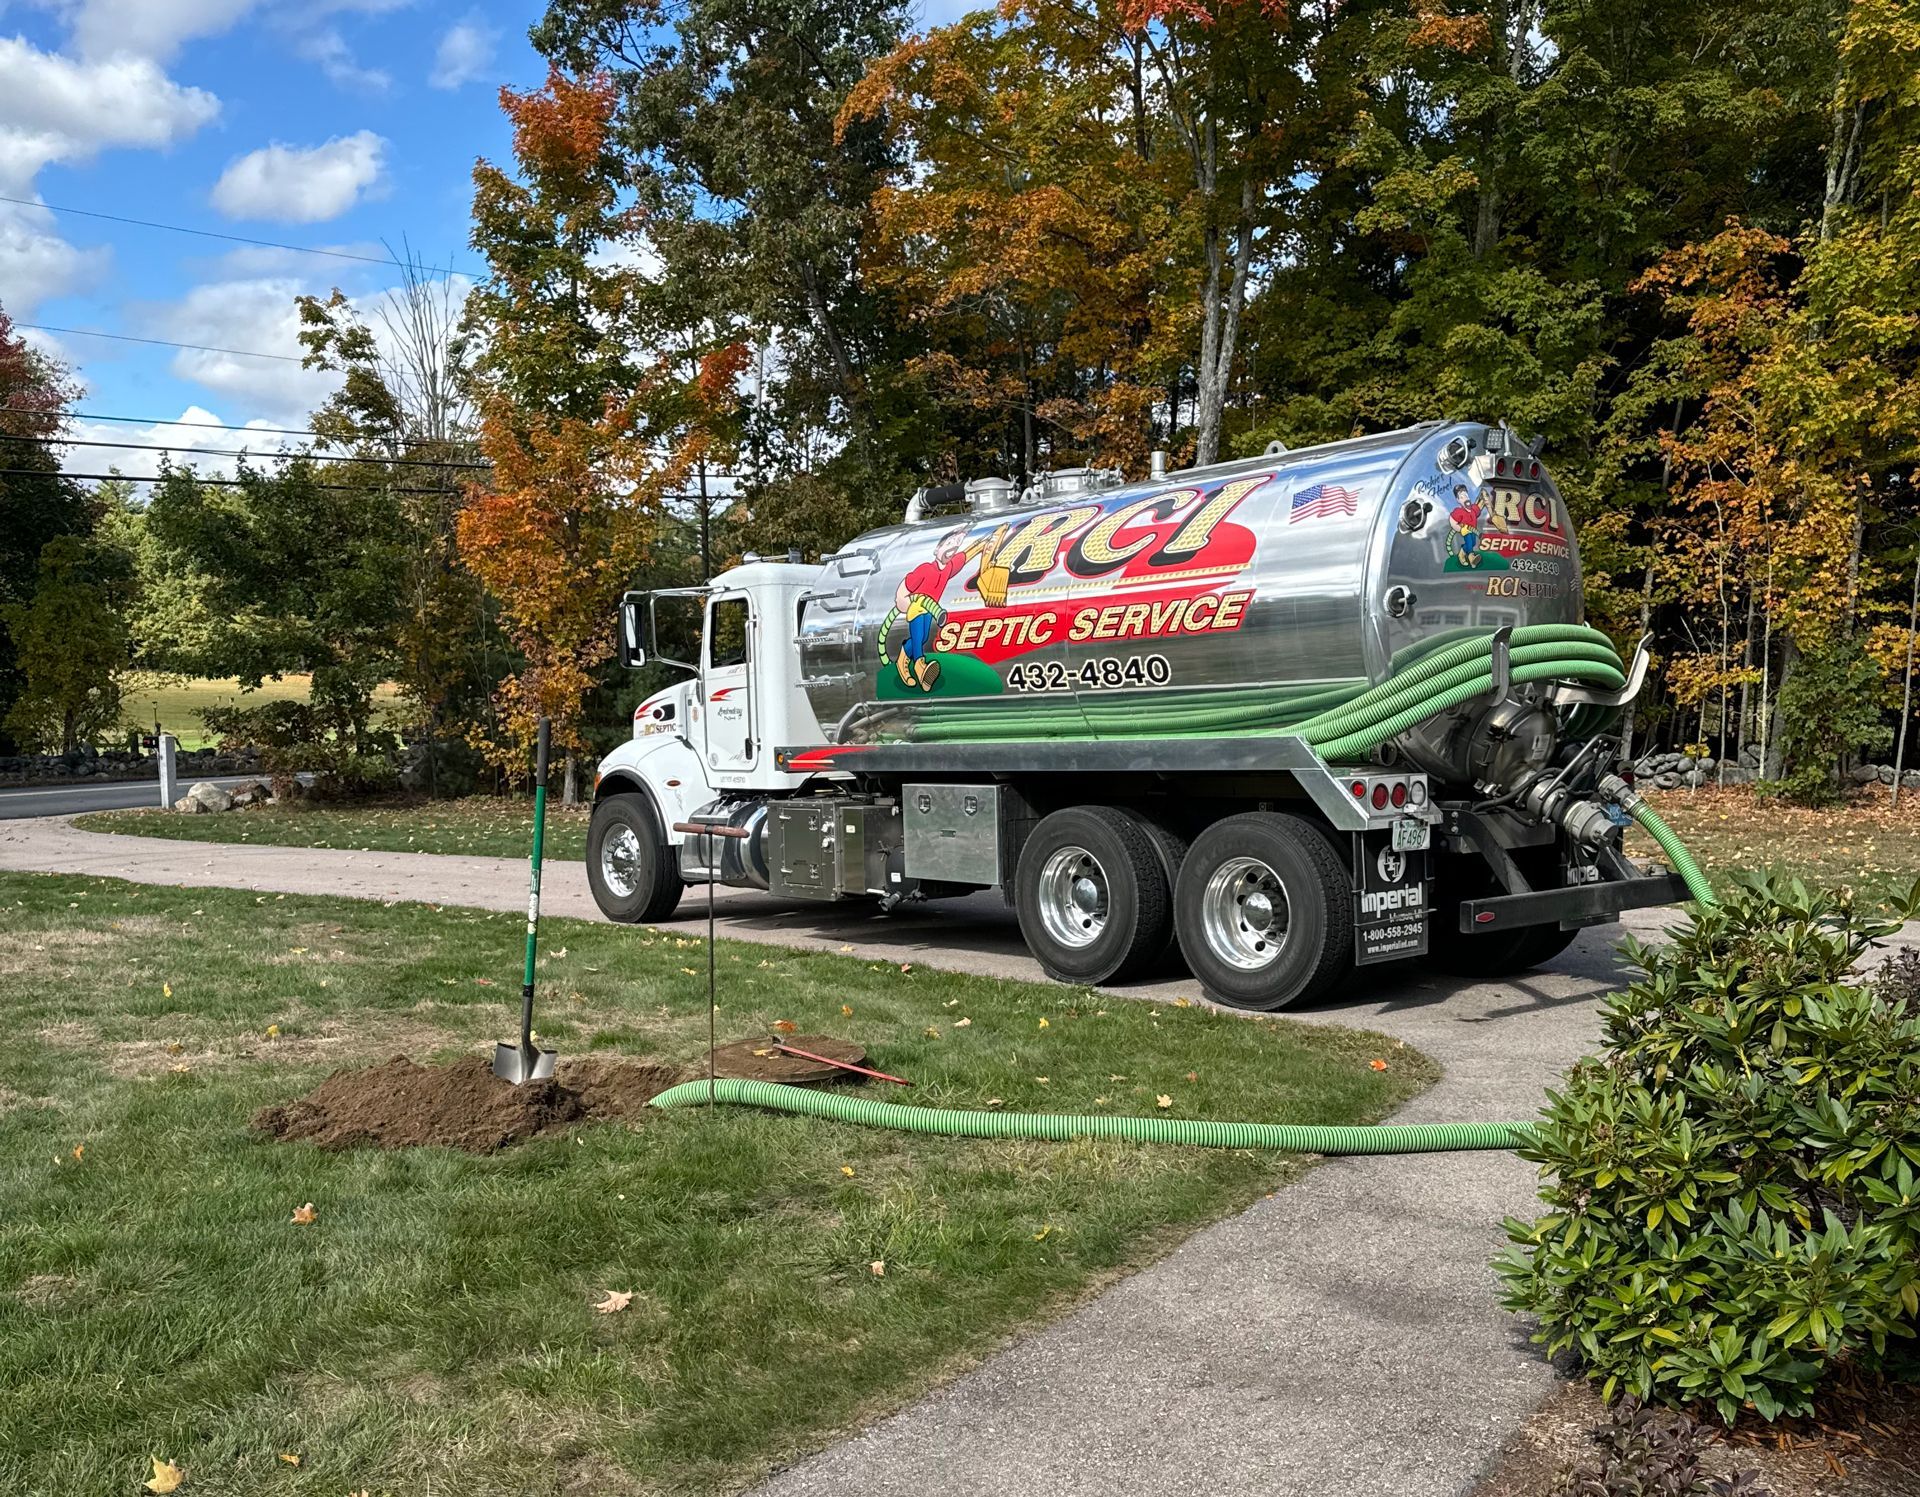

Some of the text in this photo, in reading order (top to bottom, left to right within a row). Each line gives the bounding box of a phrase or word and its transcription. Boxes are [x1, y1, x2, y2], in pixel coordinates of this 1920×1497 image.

[1427, 476, 1452, 498] Here!
[1493, 488, 1559, 532] RCI
[992, 474, 1273, 577] RCI
[1480, 538, 1570, 559] SEPTIC SERVICE
[1511, 559, 1560, 576] 432-4840
[1486, 576, 1520, 597] RCI
[935, 592, 1253, 654] SEPTIC SERVICE
[1008, 654, 1172, 692] 432-4840
[656, 723, 677, 734] SEPTIC
[1361, 882, 1422, 919] imperial
[1363, 922, 1423, 942] 1-800-558-2945
